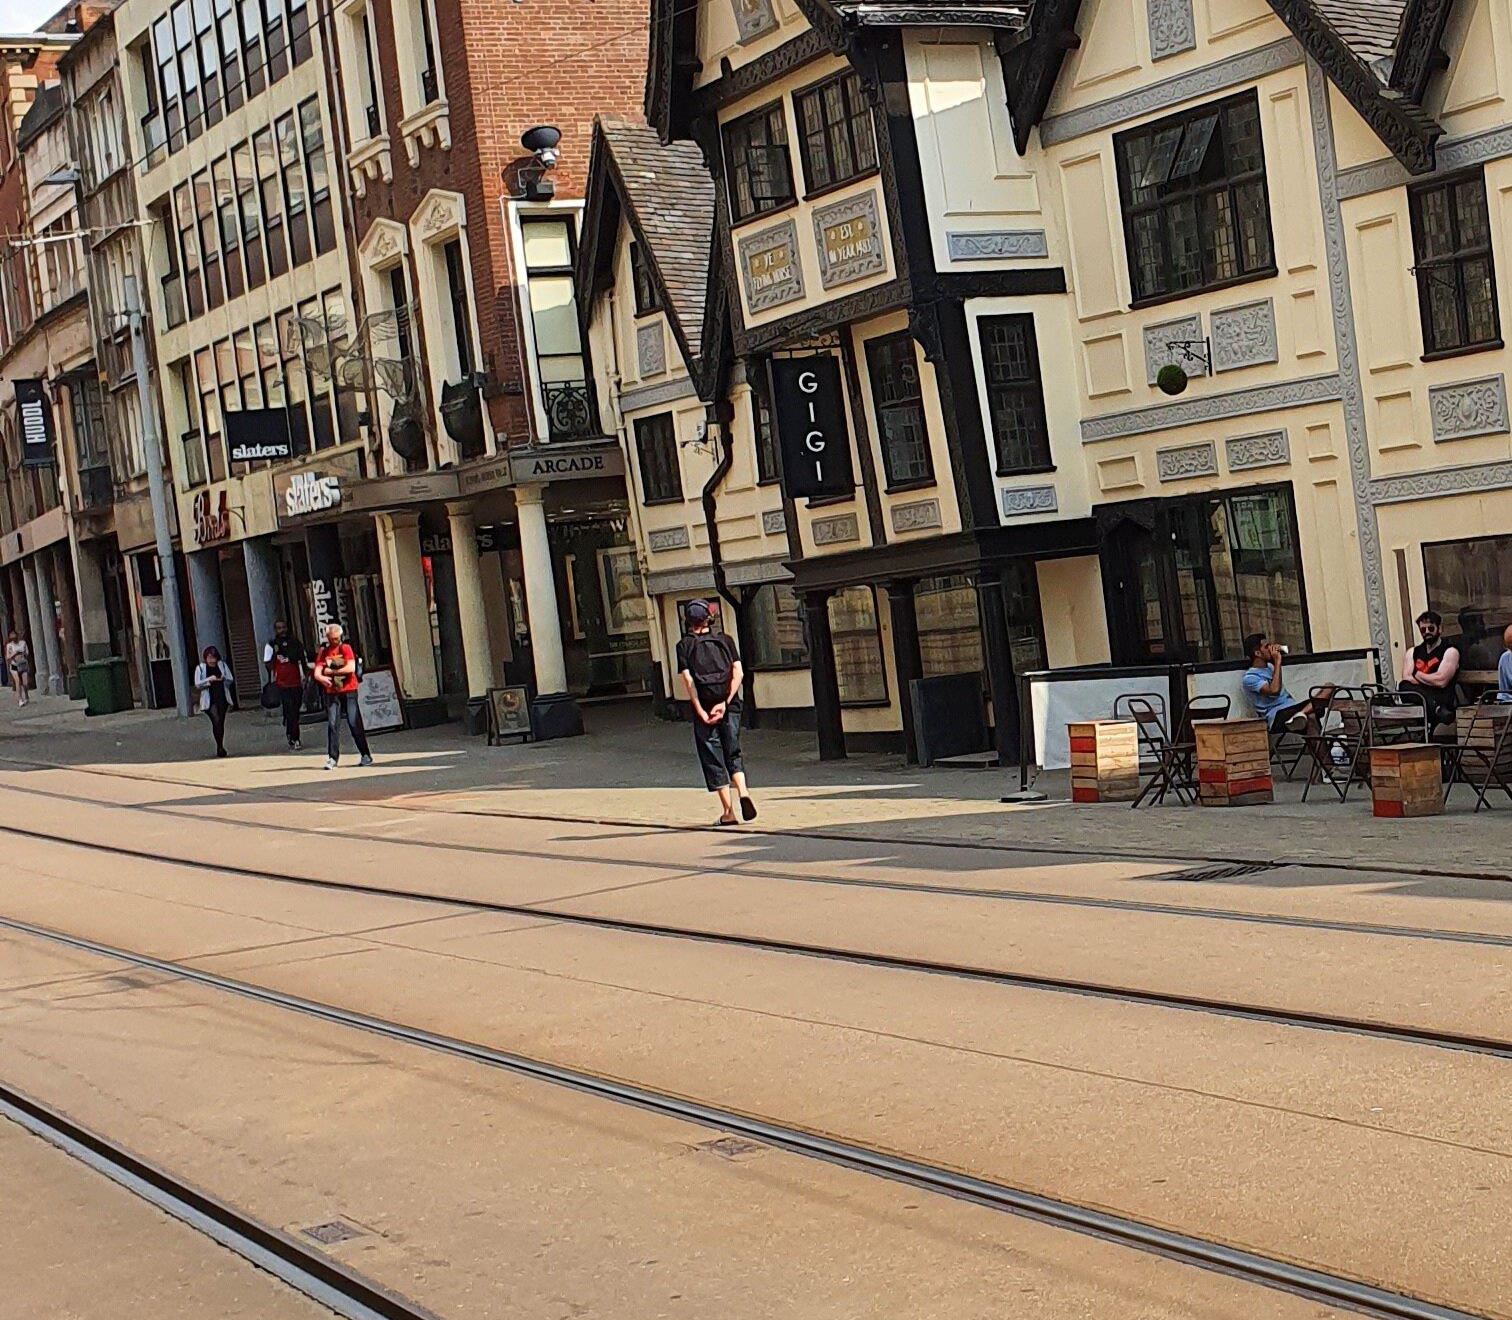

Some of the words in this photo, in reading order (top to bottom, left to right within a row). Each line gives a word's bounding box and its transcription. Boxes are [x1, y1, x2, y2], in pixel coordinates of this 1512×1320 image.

[798, 372, 825, 481] GIGI
[232, 443, 289, 459] slaters
[533, 456, 604, 474] ARCADE
[286, 471, 340, 517] slaters
